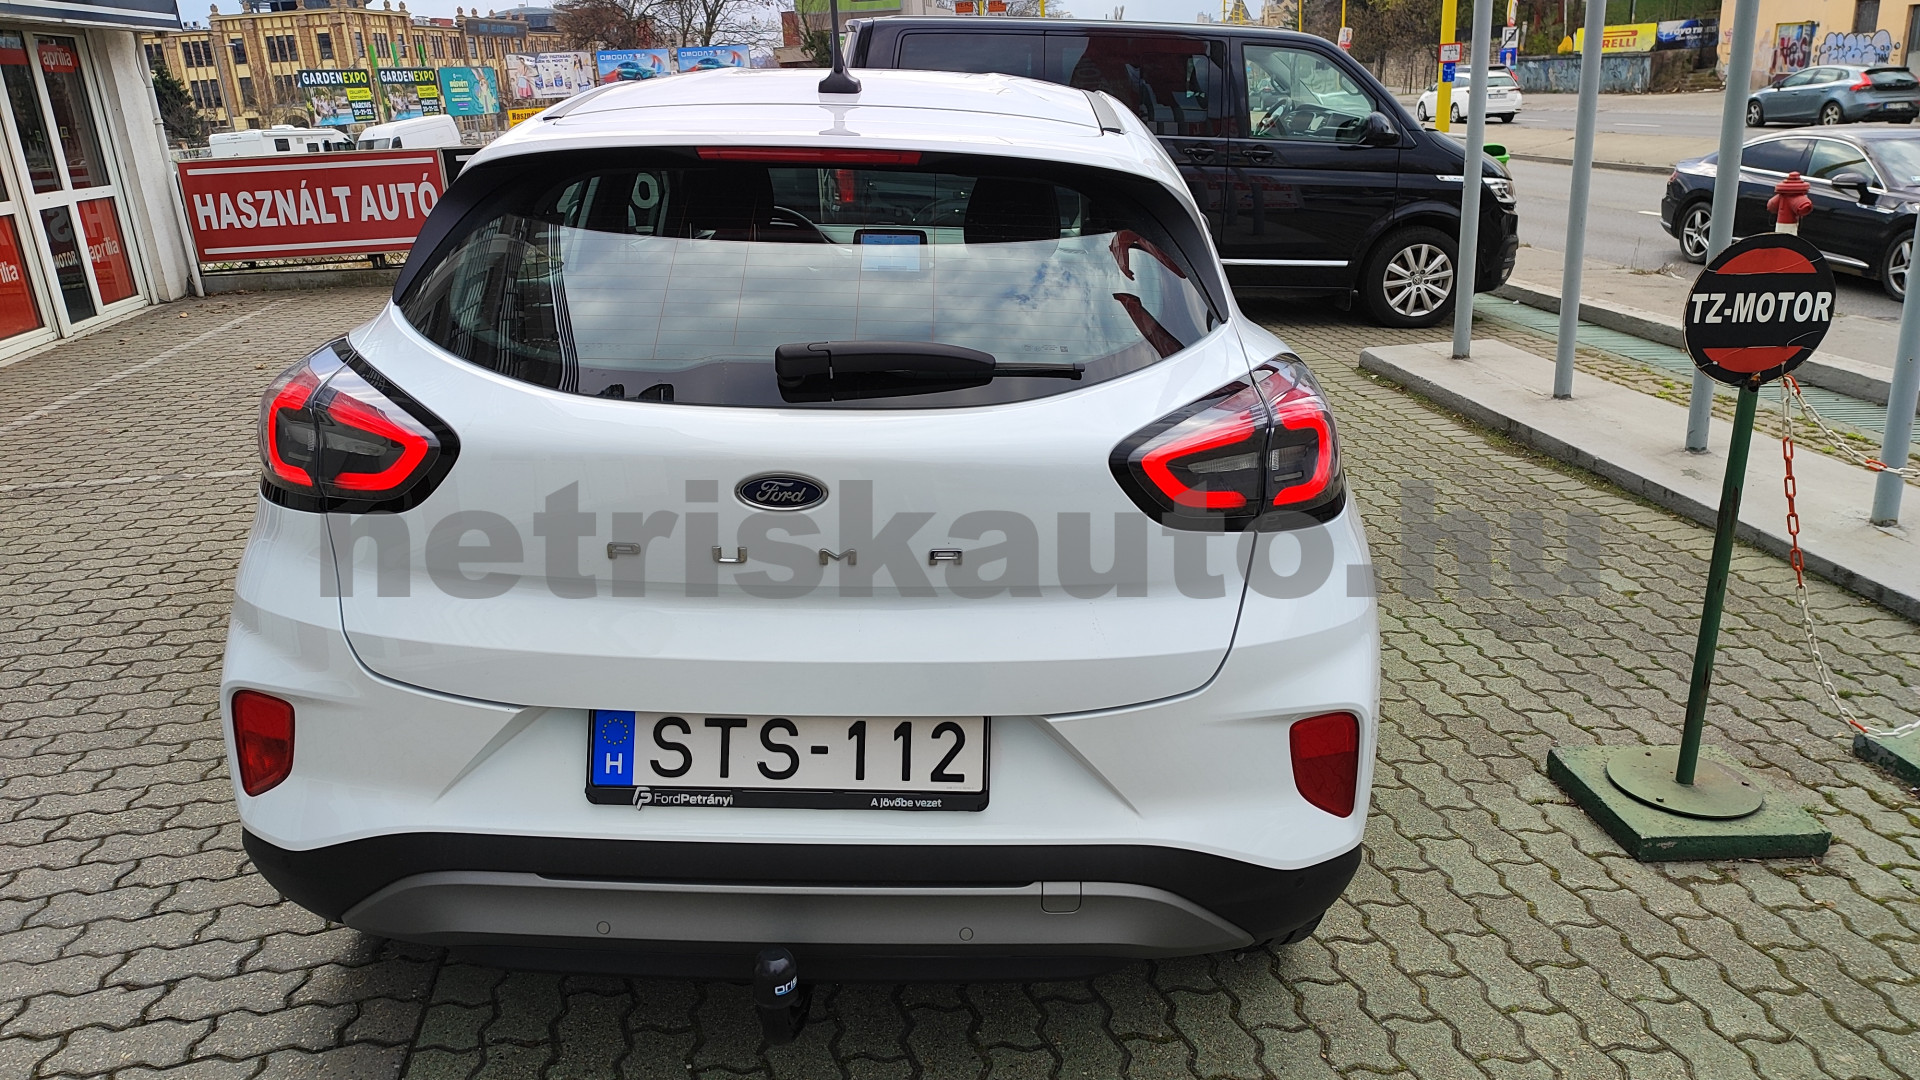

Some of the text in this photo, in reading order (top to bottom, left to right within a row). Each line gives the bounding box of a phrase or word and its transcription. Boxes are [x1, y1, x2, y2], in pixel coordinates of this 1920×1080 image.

[1602, 38, 1636, 48] RELLI
[42, 48, 72, 70] aprilia
[302, 71, 367, 84] GARDENEXPO
[380, 70, 434, 82] GARDENEXPO
[193, 173, 438, 230] HASZNÁLT AUTÓ
[89, 237, 120, 263] aprilia
[1691, 291, 1832, 324] TZ-MOTOR
[756, 481, 806, 502] Ford
[607, 542, 962, 566] PUMA
[605, 716, 966, 782] H STS-112
[654, 793, 734, 807] FordPetrányi
[870, 798, 878, 807] A
[915, 799, 942, 807] vezet
